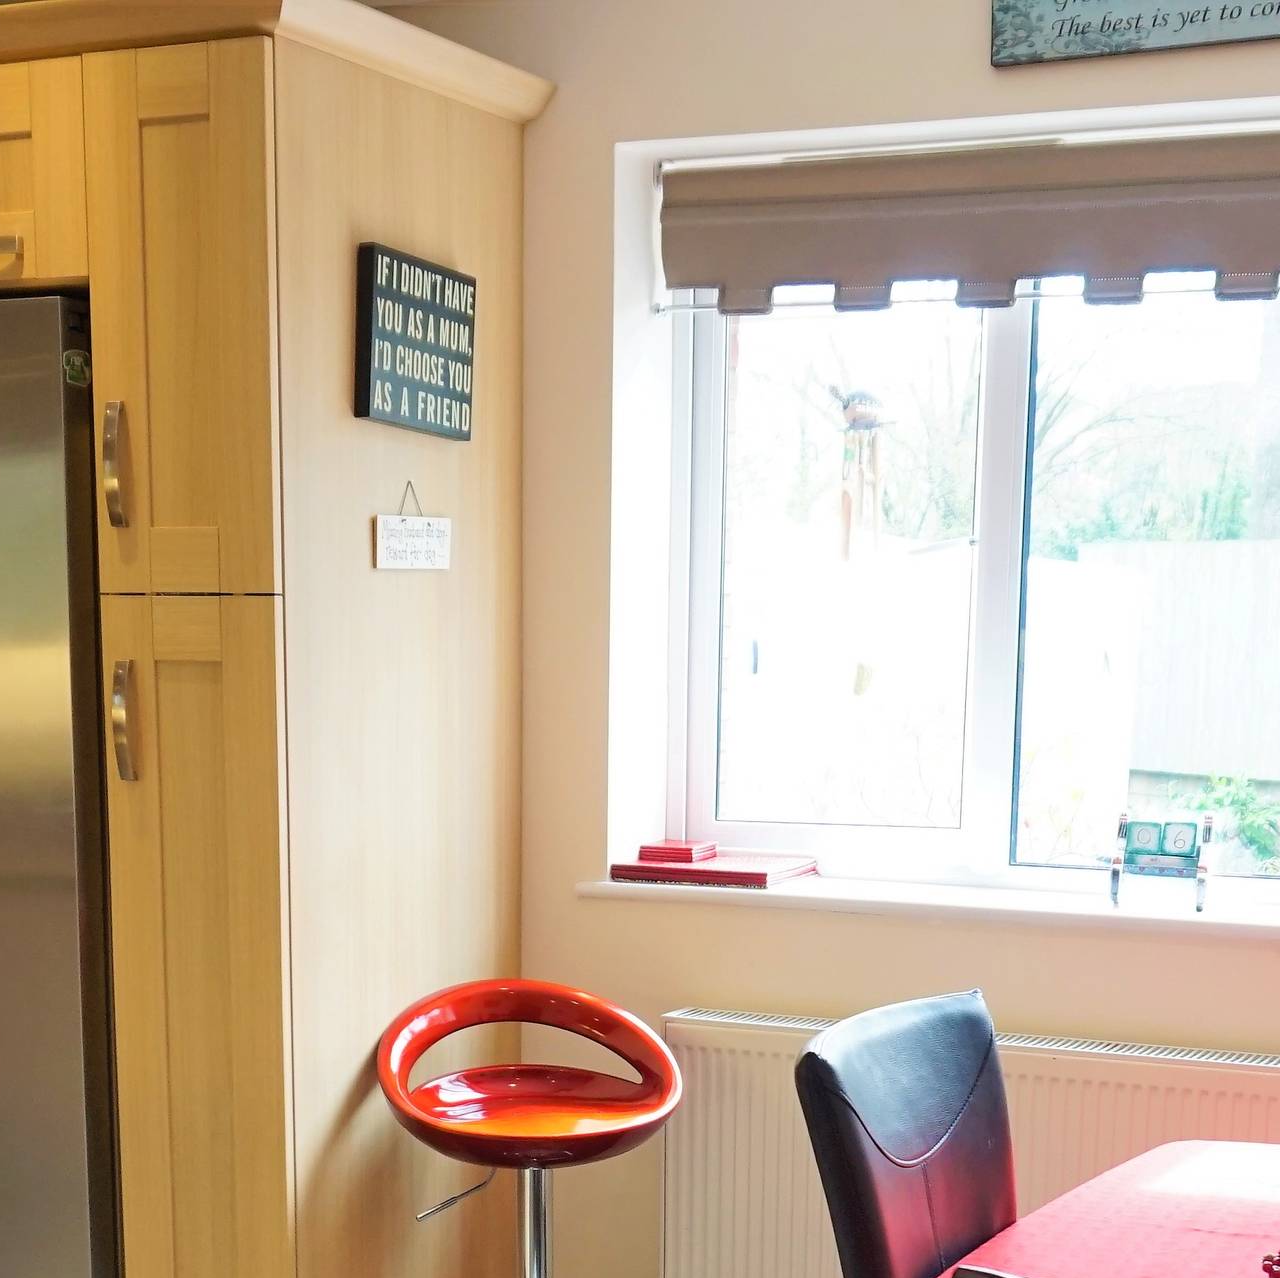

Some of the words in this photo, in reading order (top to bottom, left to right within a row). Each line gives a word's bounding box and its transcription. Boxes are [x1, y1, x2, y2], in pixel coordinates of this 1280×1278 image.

[1052, 15, 1092, 38] The
[1100, 11, 1144, 33] best
[1152, 8, 1170, 28] is
[1173, 6, 1210, 32] yet
[1220, 4, 1242, 21] to
[376, 254, 390, 287] IF
[392, 260, 397, 290] I
[401, 262, 442, 304] DIDN'T
[444, 278, 474, 315] HAVE
[376, 297, 403, 334] YOU
[407, 307, 423, 340] AS
[427, 314, 435, 344] A
[439, 317, 472, 356] MUM,
[374, 338, 392, 371] I'D
[396, 344, 444, 387] CHOOSE
[448, 361, 471, 394] YOU
[373, 379, 392, 412] AS
[400, 386, 409, 417] A
[417, 391, 470, 432] FRIEND
